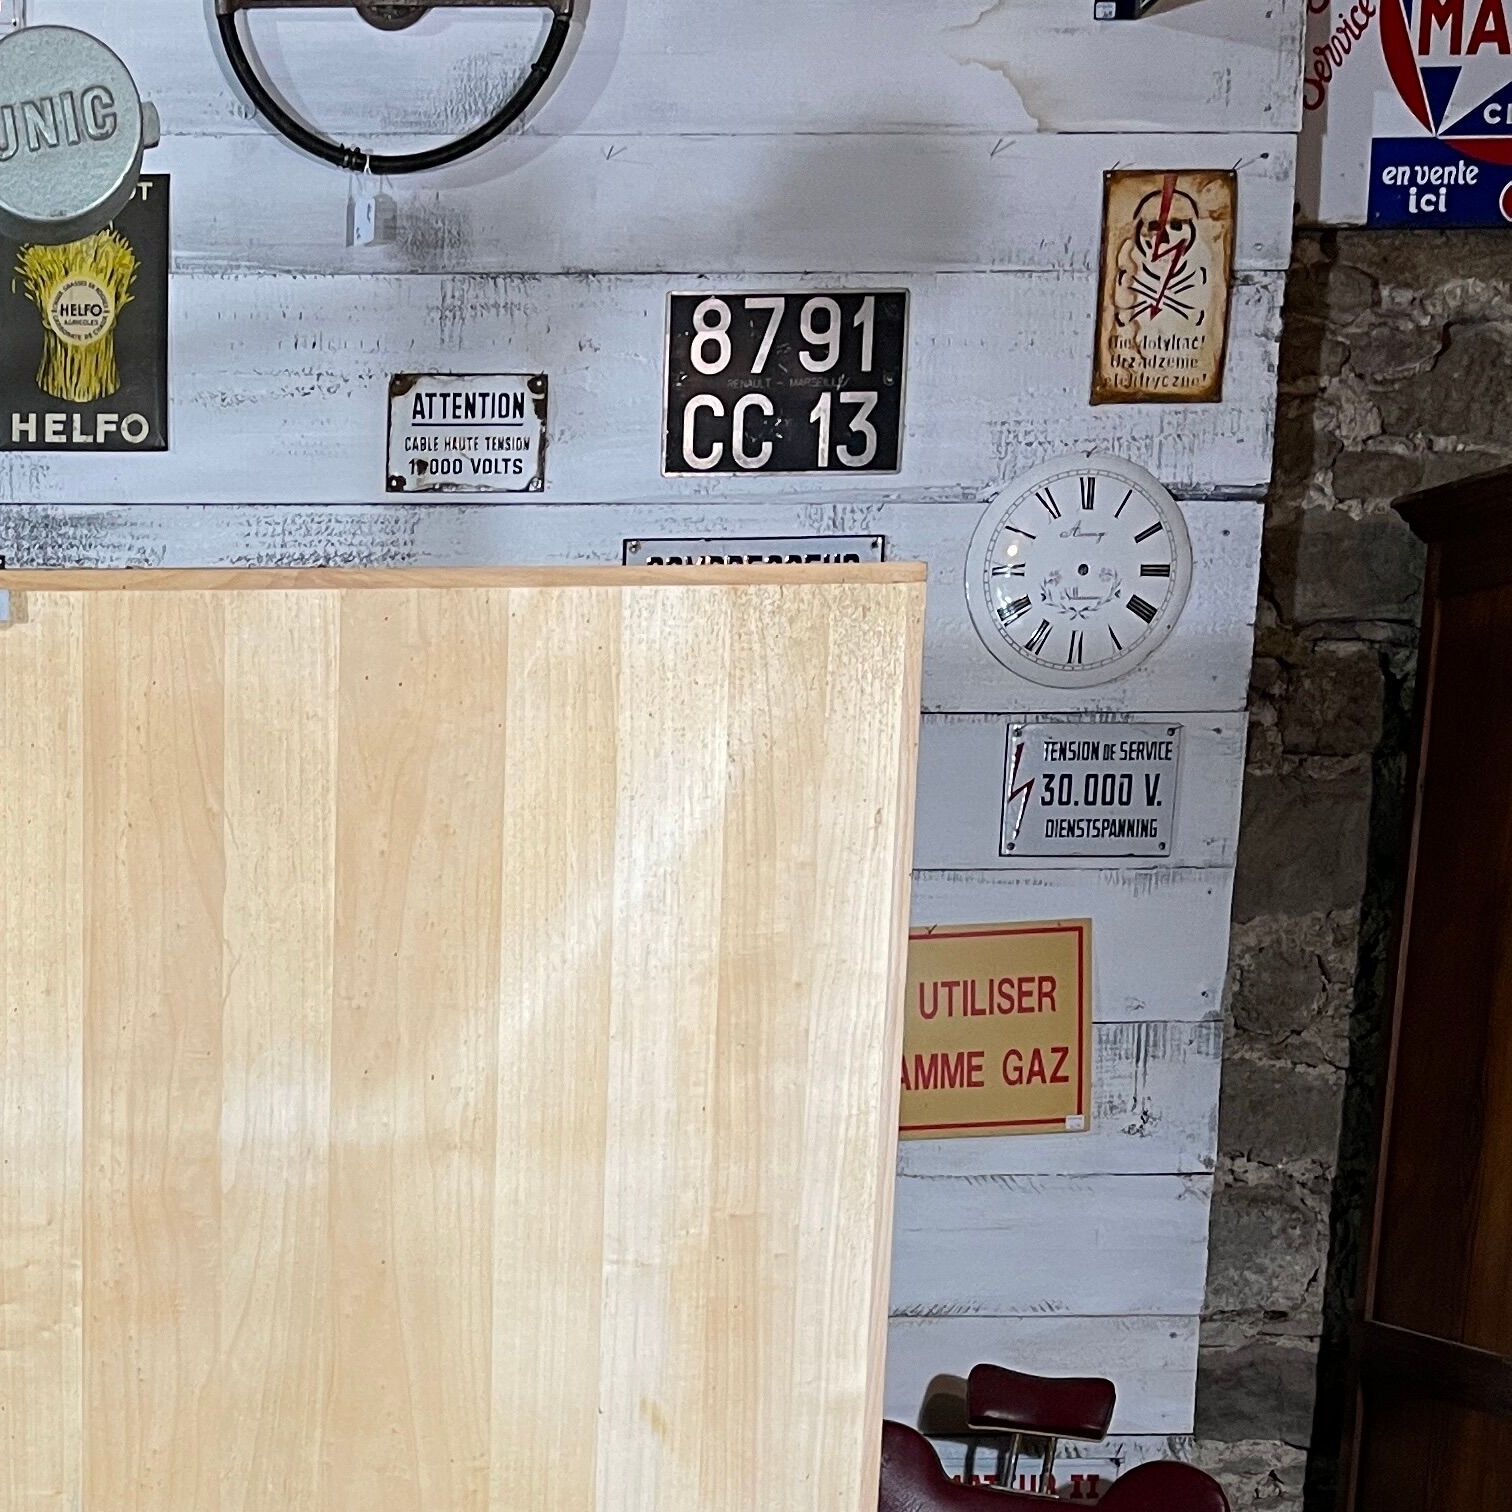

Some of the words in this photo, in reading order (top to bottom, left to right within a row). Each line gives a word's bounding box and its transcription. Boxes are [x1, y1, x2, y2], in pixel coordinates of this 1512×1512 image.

[1382, 165, 1411, 185] en
[1415, 160, 1479, 185] vente
[1408, 187, 1447, 213] ici
[60, 303, 102, 317] HELFO
[691, 296, 875, 375] 8791
[412, 392, 524, 419] ATTENTION
[12, 413, 149, 443] HELFO
[682, 393, 774, 470] CC
[810, 391, 878, 467] 13
[405, 436, 438, 451] CABLE
[444, 436, 479, 451] HAUTE
[485, 436, 530, 451] TENSION
[408, 458, 463, 475] 1000
[471, 458, 523, 475] VOLTS
[1044, 741, 1100, 761] TENSION
[1103, 744, 1116, 761] DE
[1120, 741, 1173, 761] SERVICE
[1041, 773, 1133, 806] 30.000
[1145, 773, 1162, 806] V.
[1045, 819, 1158, 838] DIENSTSPANNING
[919, 975, 1056, 1019] UTILISER
[1002, 1046, 1069, 1085] GAZ
